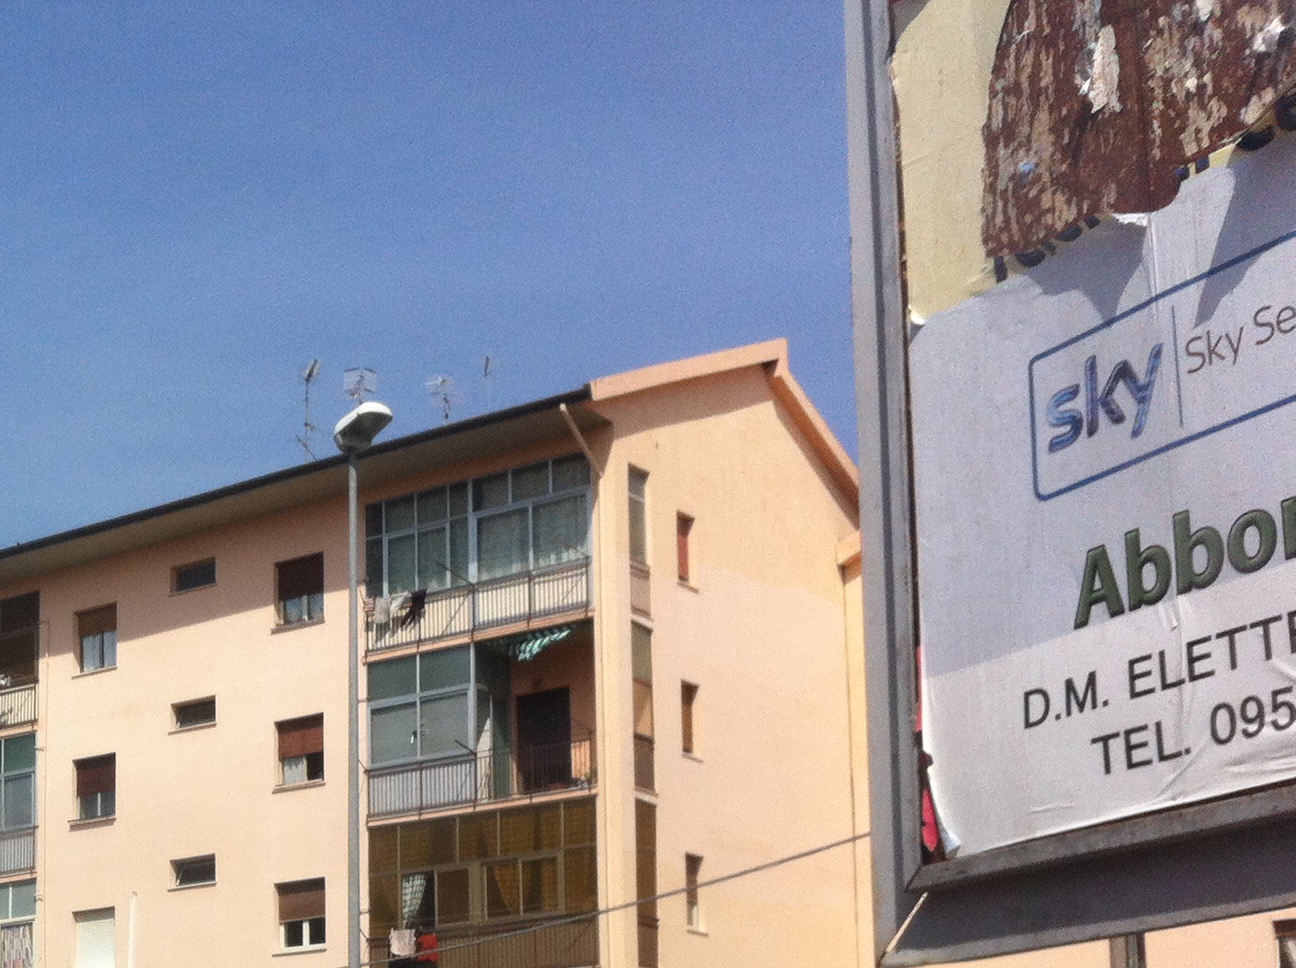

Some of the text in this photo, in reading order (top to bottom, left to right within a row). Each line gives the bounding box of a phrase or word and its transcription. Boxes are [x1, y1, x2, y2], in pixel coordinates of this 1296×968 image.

[1047, 342, 1164, 455] sky
[1185, 326, 1244, 375] Sky
[1023, 609, 1296, 729] D.M. ELETT
[1090, 686, 1296, 775] TEL. 095
